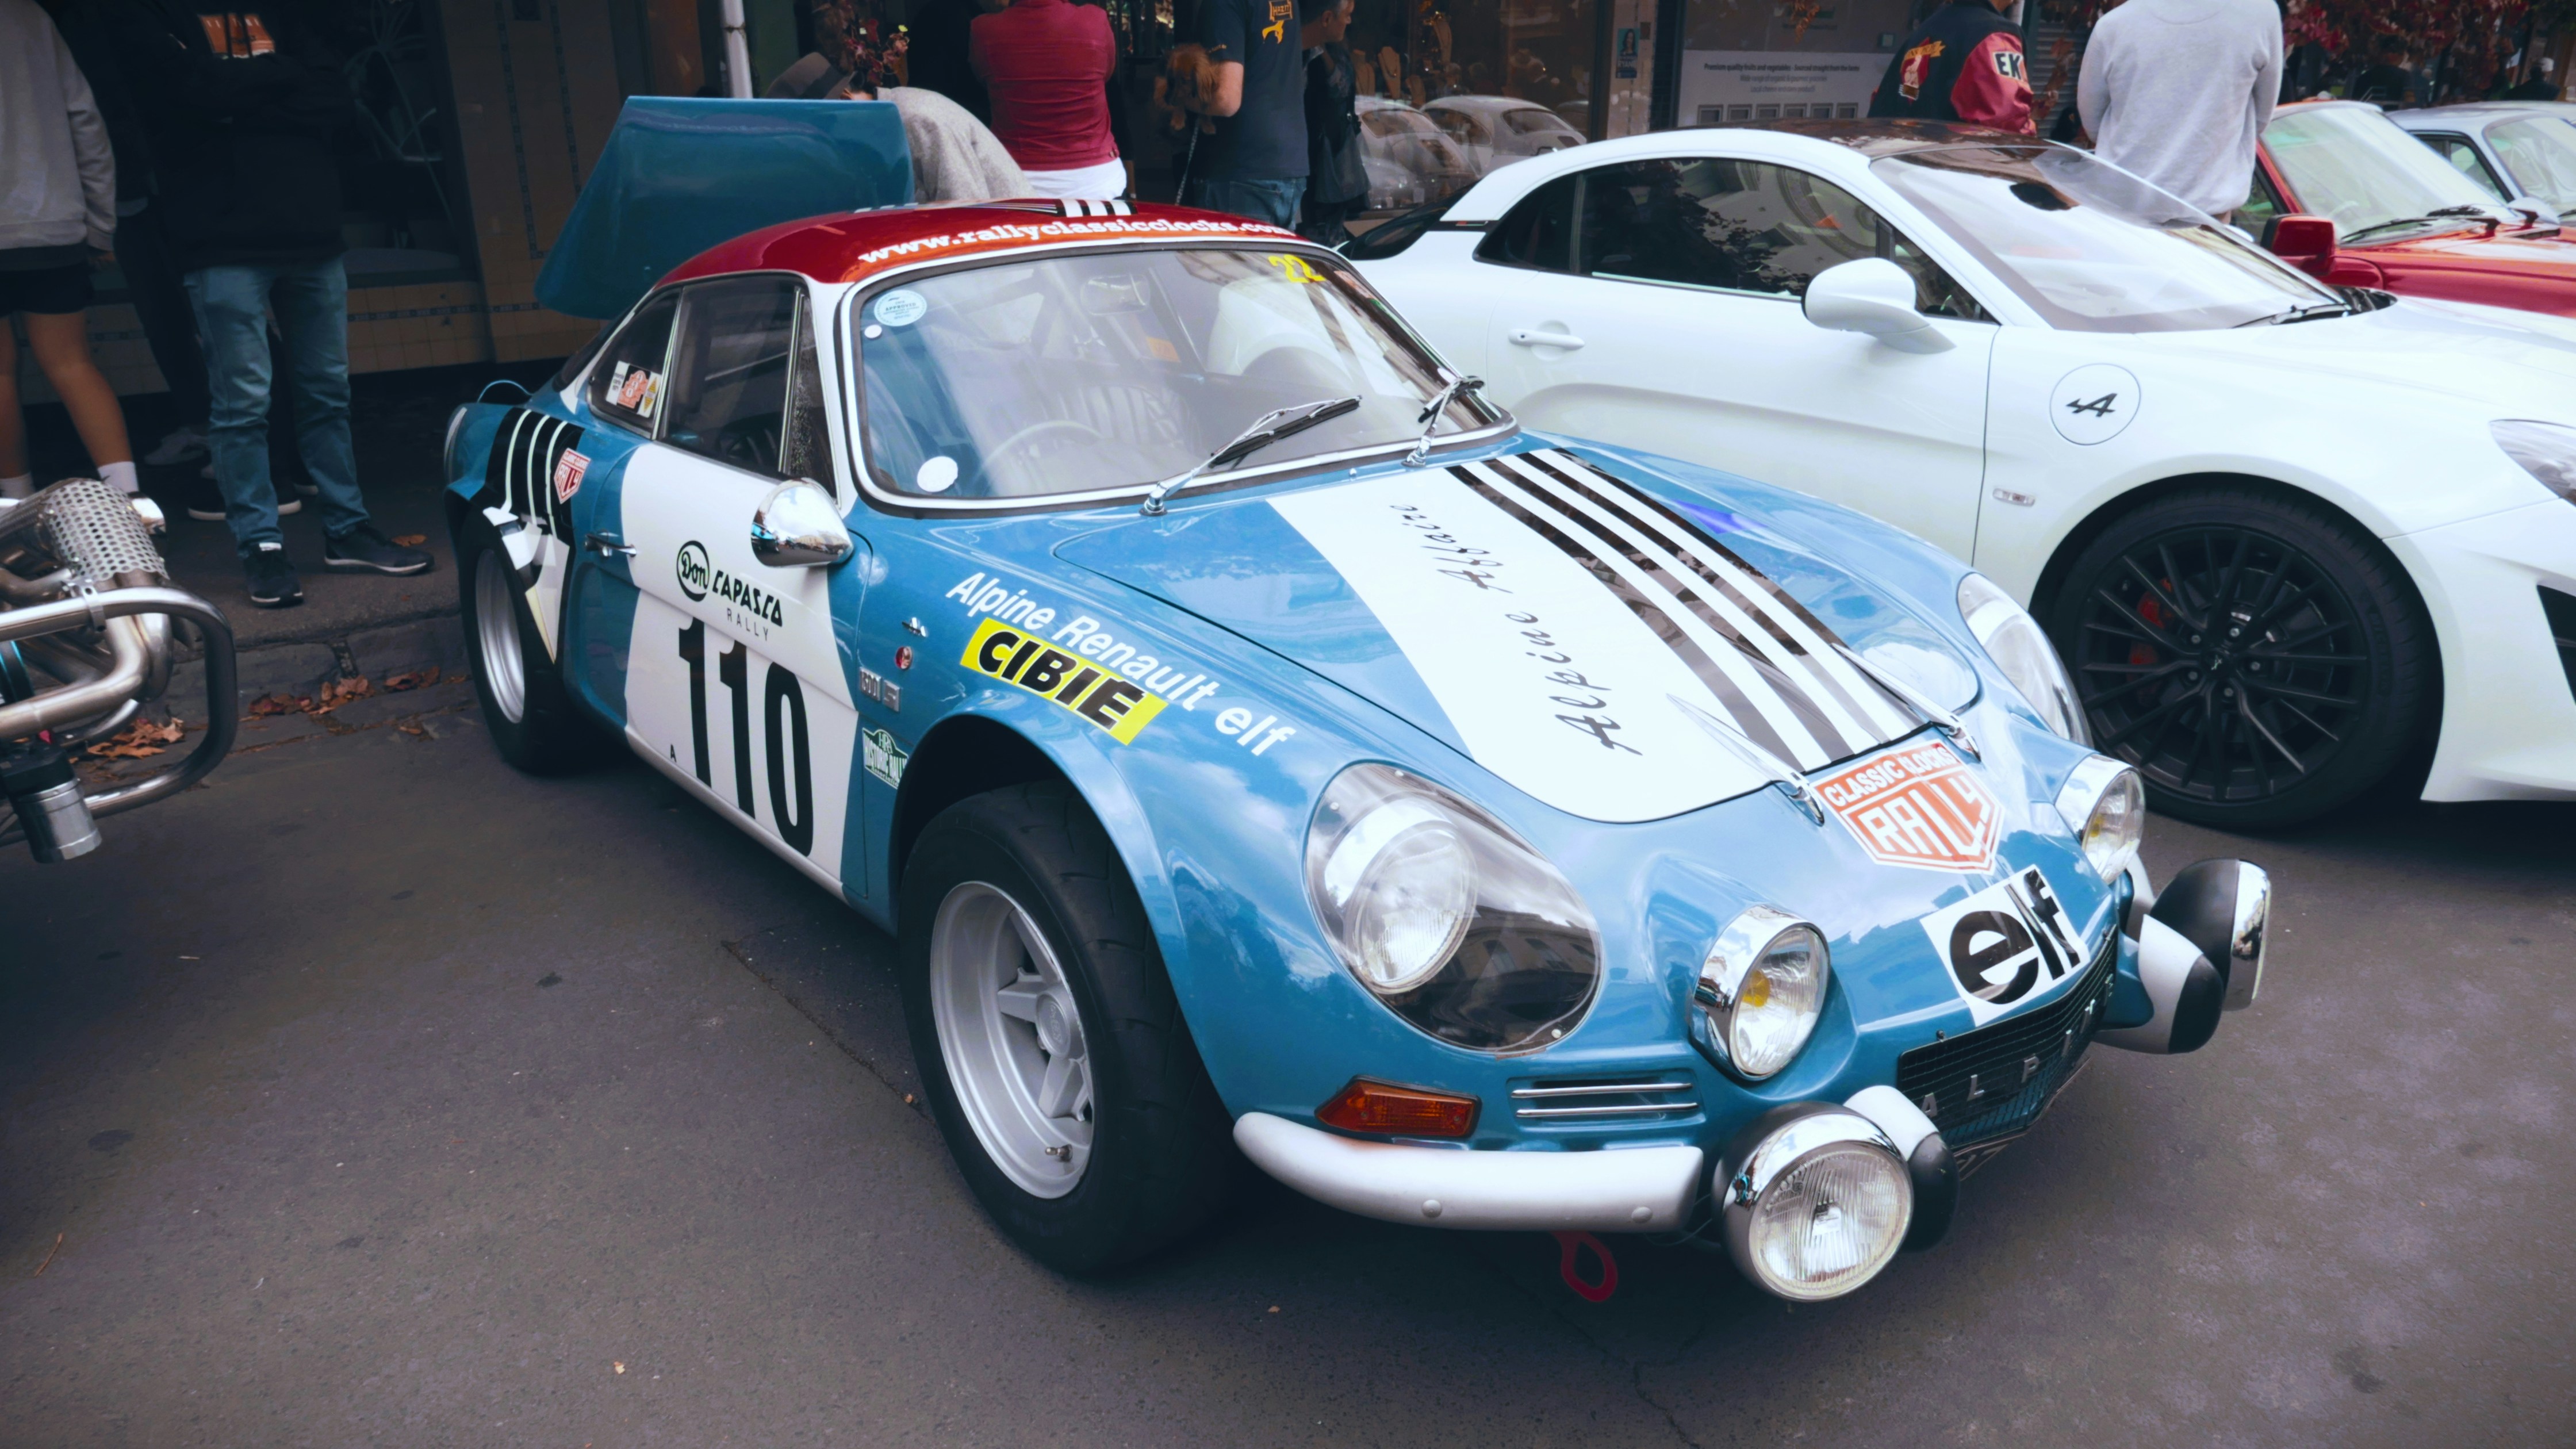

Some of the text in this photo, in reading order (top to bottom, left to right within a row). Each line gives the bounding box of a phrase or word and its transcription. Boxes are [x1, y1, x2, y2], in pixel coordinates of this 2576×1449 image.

[1727, 63, 1743, 71] quality
[1767, 64, 1791, 72] vegetables
[1995, 53, 2022, 80] EK
[857, 218, 1297, 263] www.rallyclassicclocks.com
[1268, 254, 1326, 283] 22
[556, 463, 581, 495] RALLY
[681, 551, 708, 590] Don
[727, 608, 768, 641] RALLY
[946, 572, 1295, 756] Alpine Renault elf
[1505, 611, 1643, 756] Alpine
[670, 744, 677, 762] A
[679, 617, 814, 857] 110
[864, 733, 889, 775] HISTORIC
[878, 731, 894, 754] HRA
[1824, 747, 1954, 807] CLASSIC CLOCKS
[1858, 775, 1991, 857] RALLY
[1949, 869, 2081, 1005] elf
